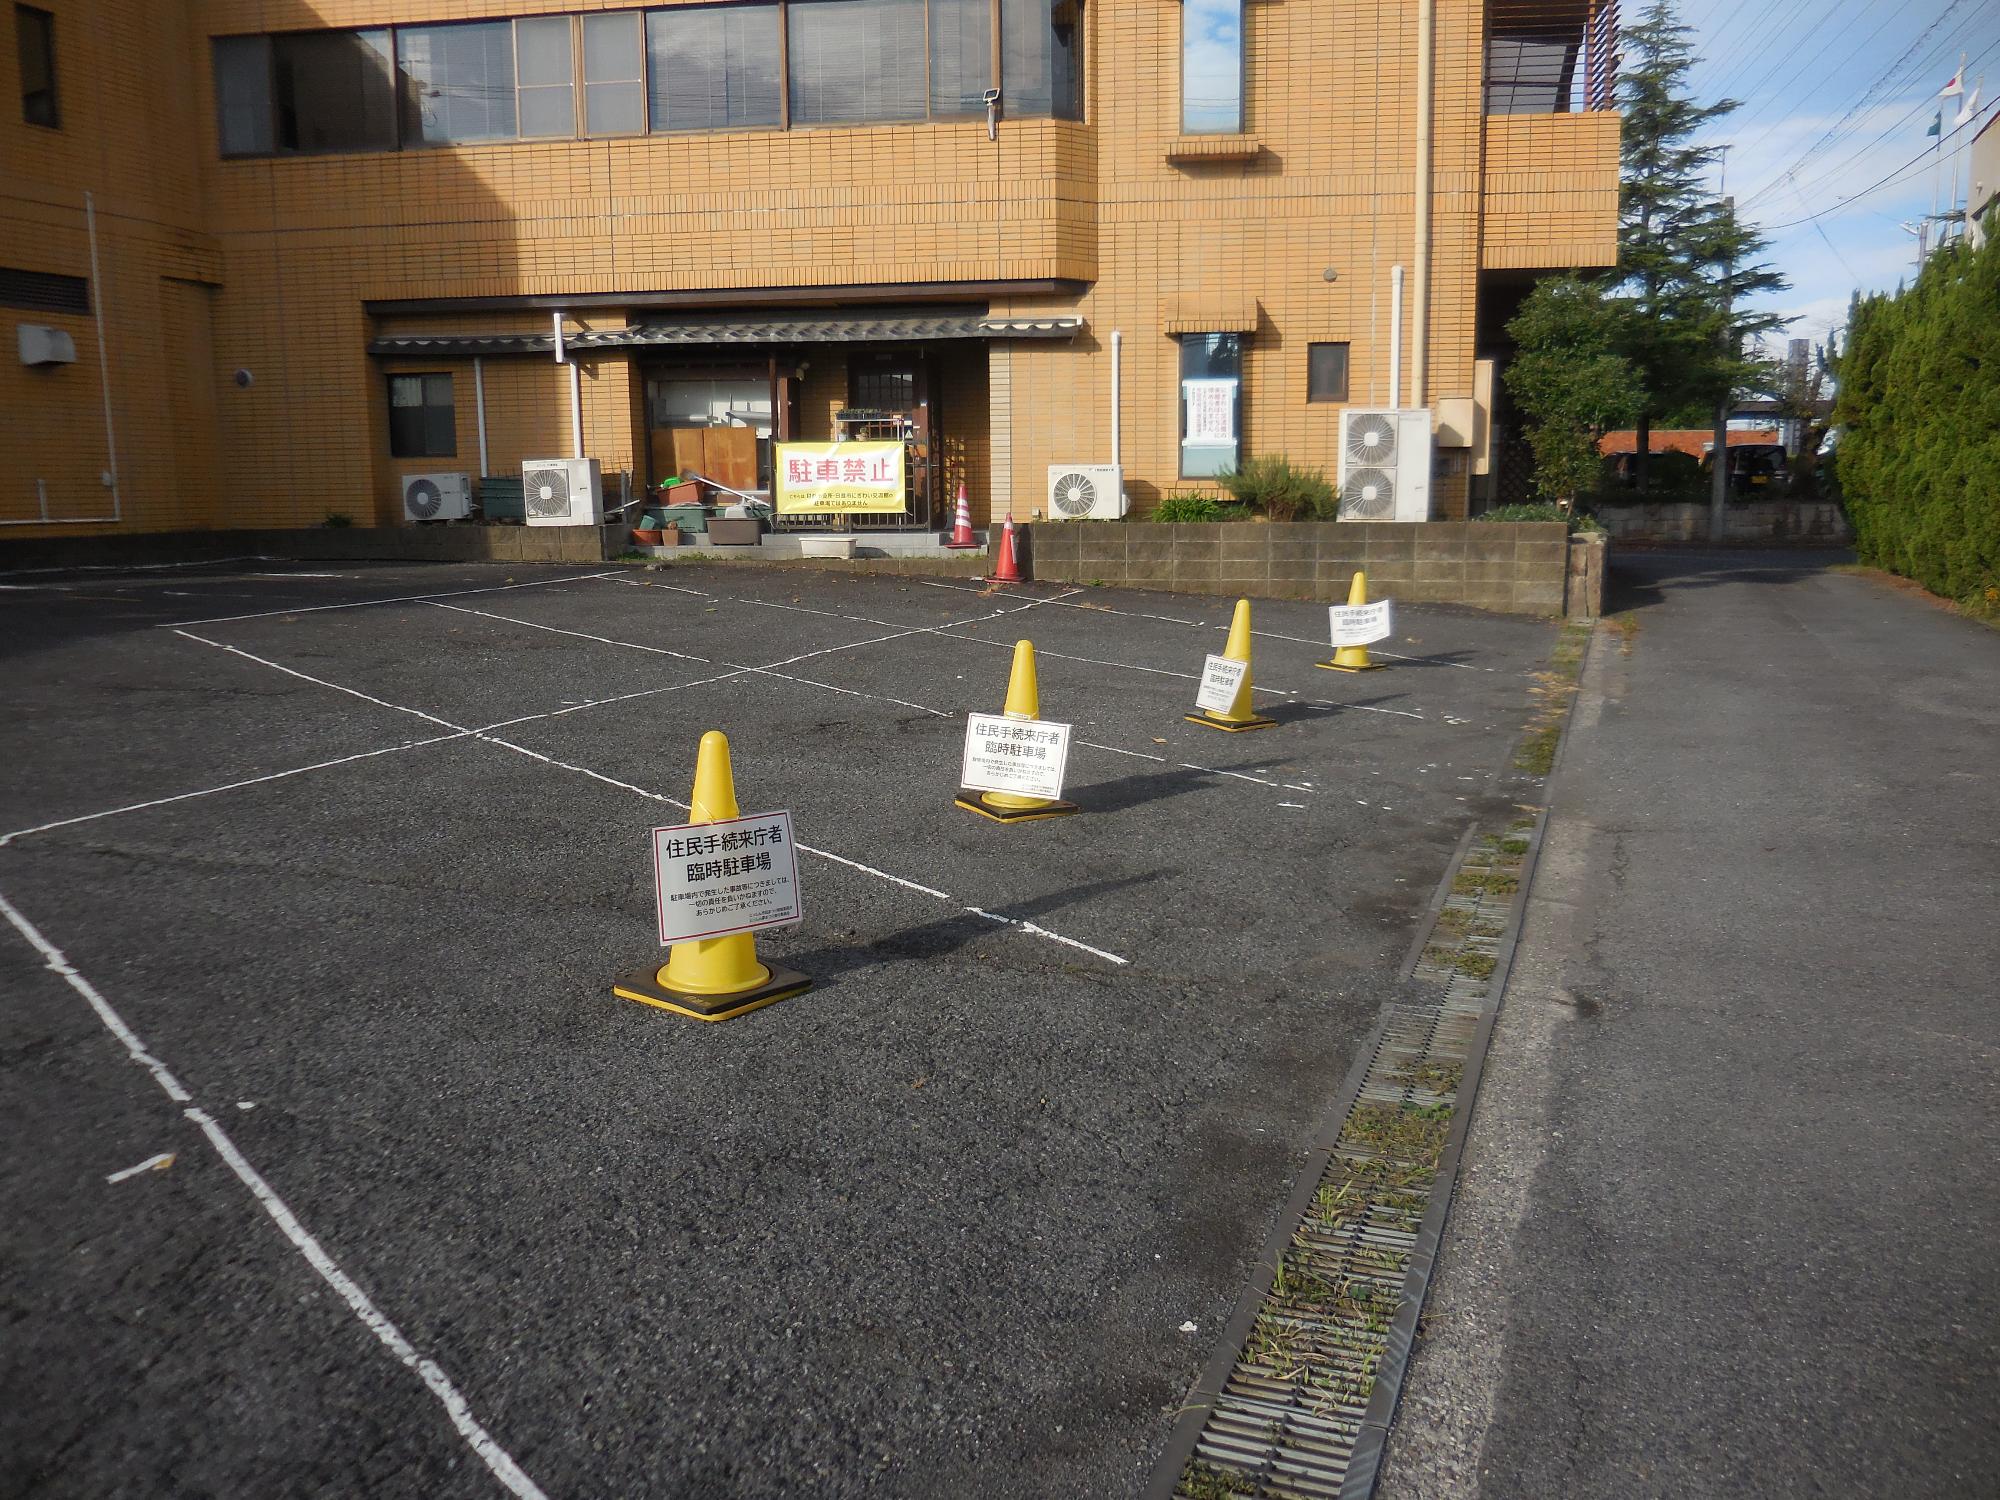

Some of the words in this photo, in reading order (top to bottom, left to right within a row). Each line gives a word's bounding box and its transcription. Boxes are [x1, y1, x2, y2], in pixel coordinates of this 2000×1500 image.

[789, 458, 893, 483] 駐車禁止
[976, 722, 1060, 745] 住民手続来庁者
[985, 740, 1047, 760] 臨時駐車場
[666, 824, 782, 859] 住民手続来庁者
[687, 851, 772, 882] 臨時駐車場
